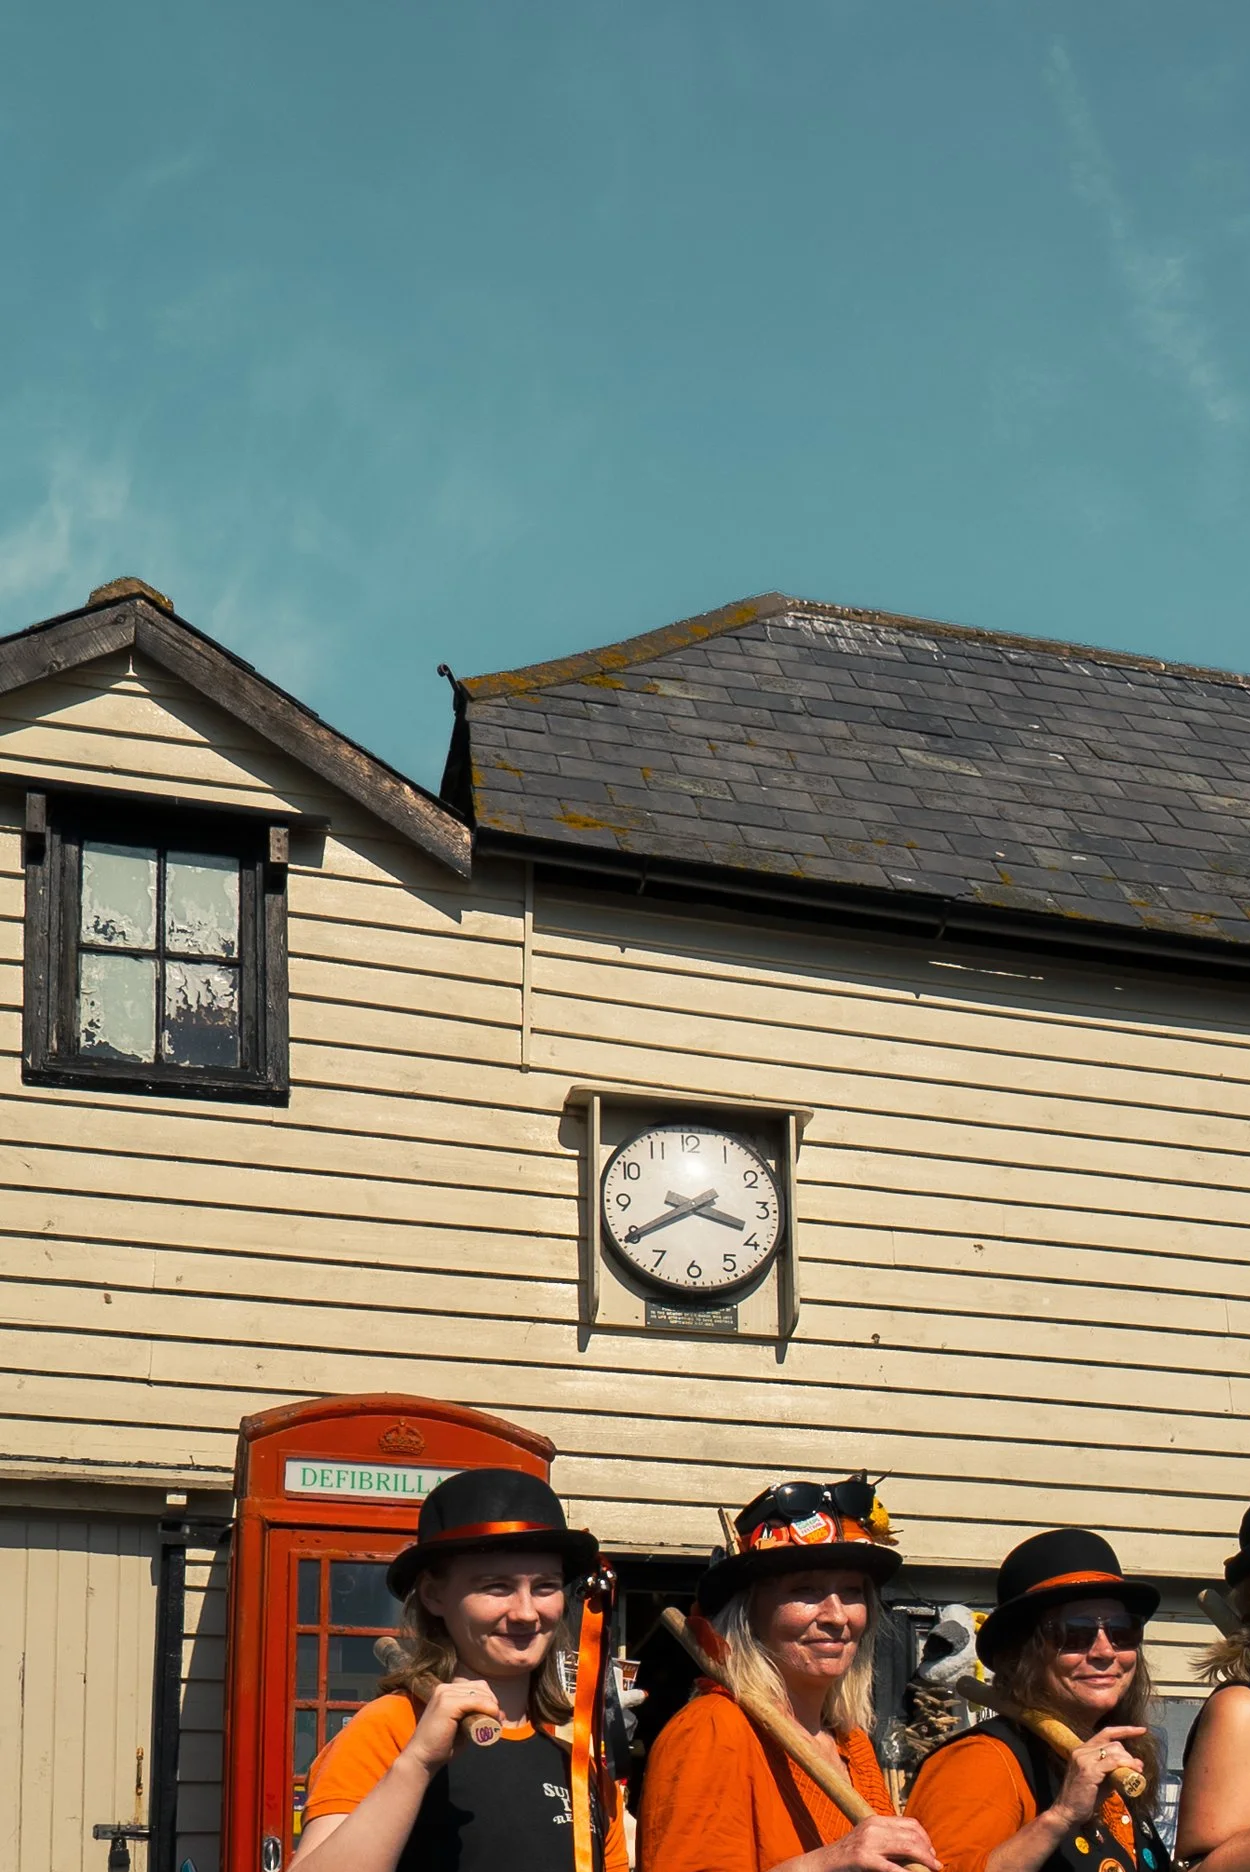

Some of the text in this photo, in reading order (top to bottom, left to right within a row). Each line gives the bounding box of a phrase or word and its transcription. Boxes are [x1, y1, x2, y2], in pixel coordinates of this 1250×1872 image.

[650, 1141, 664, 1160] 11
[681, 1135, 701, 1153] 12
[623, 1162, 640, 1180] 10
[744, 1170, 758, 1189] 2
[616, 1193, 631, 1211] 9
[756, 1201, 770, 1220] 3
[743, 1233, 760, 1250] 4
[652, 1250, 667, 1268] 7
[723, 1254, 736, 1272] 5
[687, 1260, 702, 1278] 6
